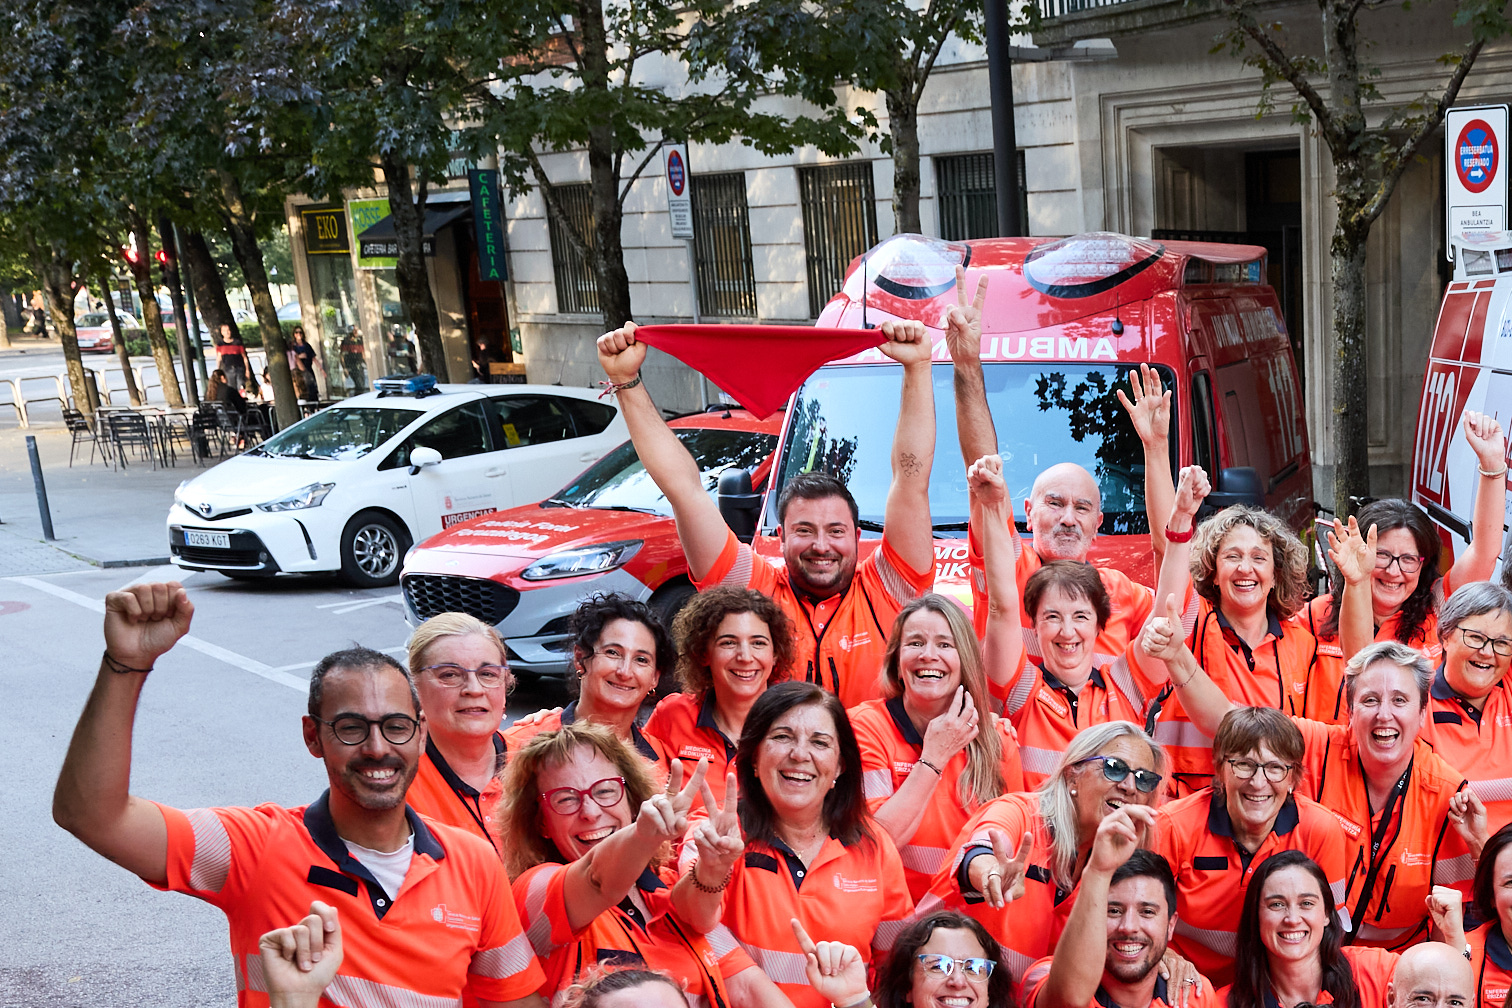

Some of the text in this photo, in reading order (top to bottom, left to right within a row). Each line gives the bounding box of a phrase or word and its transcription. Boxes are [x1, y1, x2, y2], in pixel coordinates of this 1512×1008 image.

[1463, 157, 1490, 168] RESERVADO
[315, 215, 339, 240] EKO
[478, 173, 499, 279] CAFETERIA
[1267, 355, 1303, 464] 112
[1419, 371, 1456, 495] 112
[190, 533, 227, 546] 0263 KGT
[680, 750, 715, 760] MEDIKUNTZA
[685, 745, 711, 754] MEDICINA
